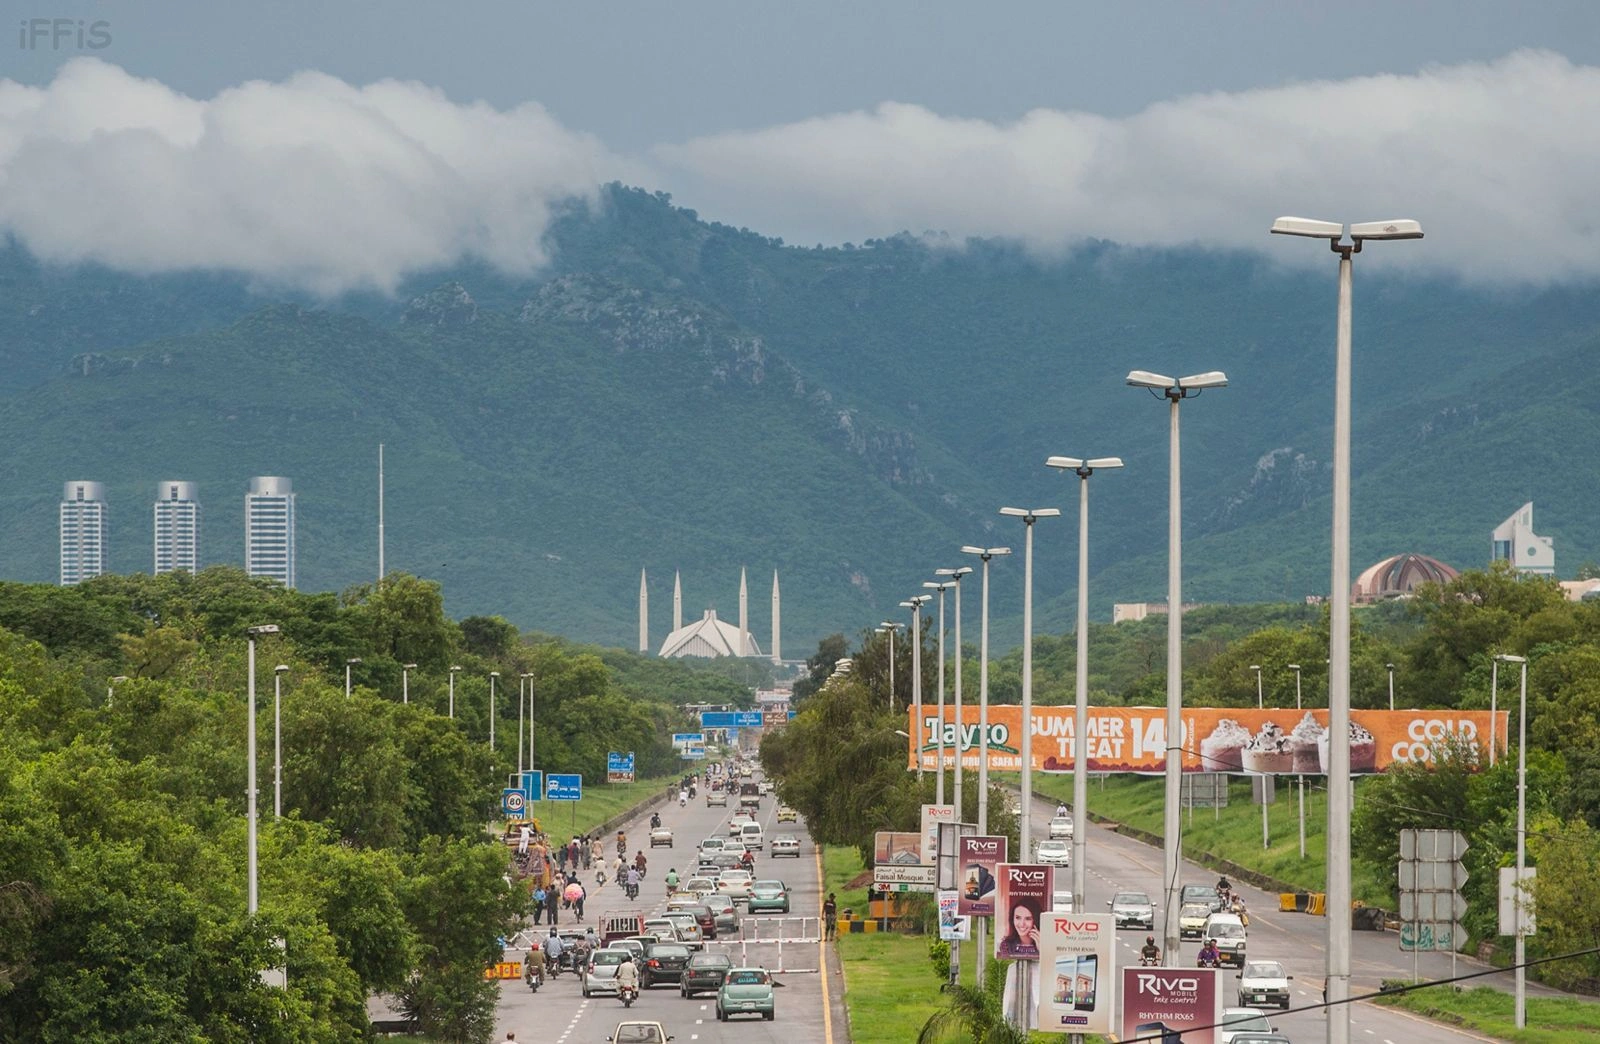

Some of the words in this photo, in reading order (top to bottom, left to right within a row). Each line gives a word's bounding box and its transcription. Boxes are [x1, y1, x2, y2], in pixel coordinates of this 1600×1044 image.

[992, 757, 1014, 767] SAFA
[1015, 757, 1037, 767] ML
[510, 798, 521, 806] 80
[928, 808, 951, 817] RIVO
[967, 840, 998, 851] RIVO
[876, 873, 895, 881] Faisal
[897, 874, 923, 882] Mosque
[1008, 869, 1045, 882] RIVO
[1054, 918, 1099, 935] RIVO
[1137, 974, 1198, 996] RIVO
[1154, 996, 1168, 1004] take
[1170, 996, 1198, 1004] control
[1139, 1012, 1173, 1020] RHYTHM
[1174, 1013, 1194, 1021] RX65
